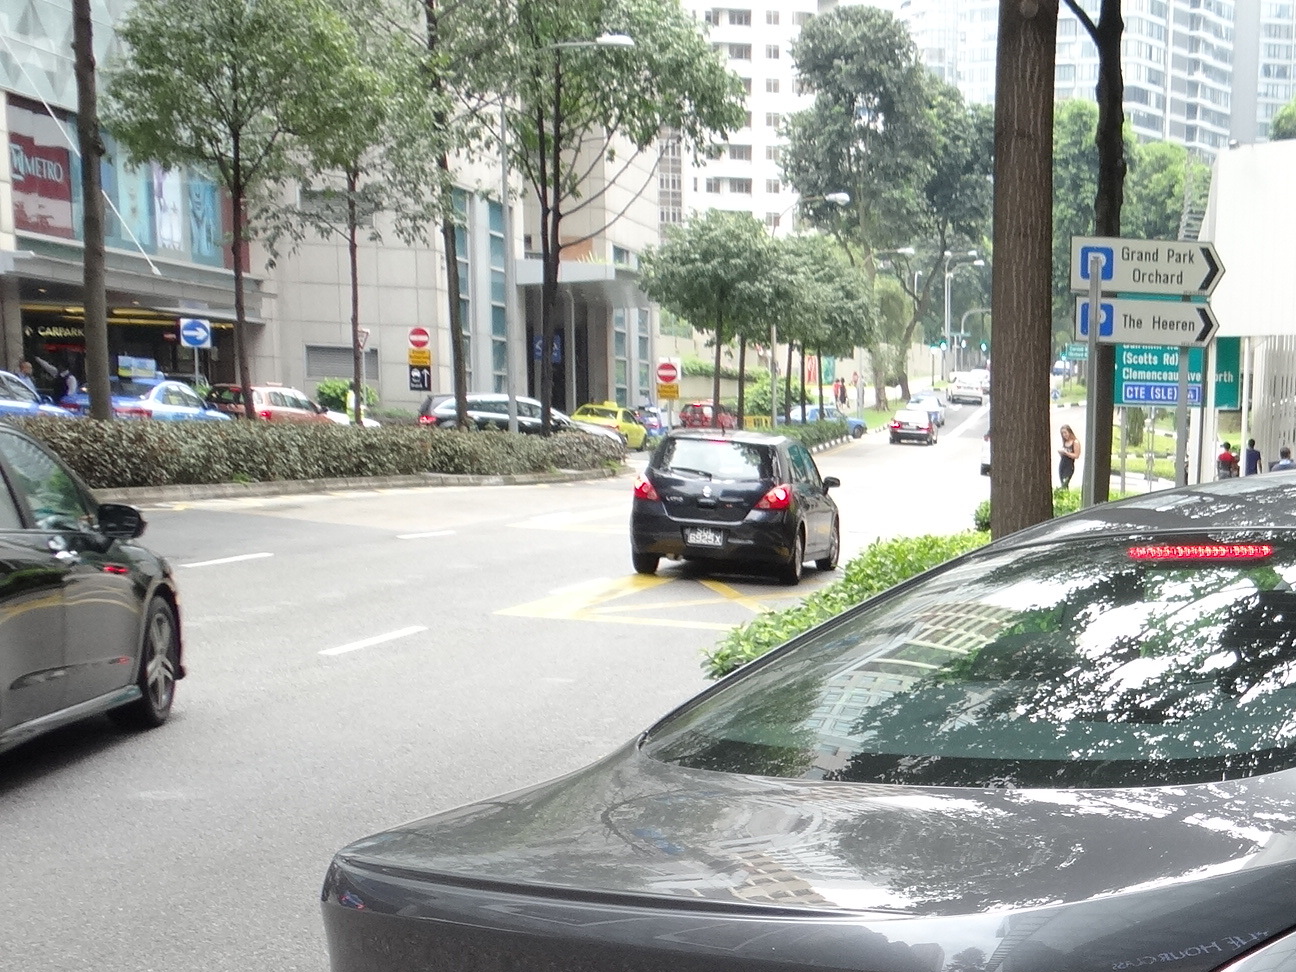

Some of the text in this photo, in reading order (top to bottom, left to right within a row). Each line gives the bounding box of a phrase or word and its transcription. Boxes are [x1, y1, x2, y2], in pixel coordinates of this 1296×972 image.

[24, 154, 63, 183] METRO
[1121, 246, 1195, 265] Grand Park
[1132, 268, 1183, 285] Orchard
[1122, 314, 1143, 329] The
[1152, 315, 1195, 332] Heeren
[1122, 351, 1179, 366] (Scotts Rd)
[1122, 367, 1234, 383] Clemenceau ve orth
[1126, 386, 1146, 399] CTE
[1150, 385, 1178, 400] (SLE)
